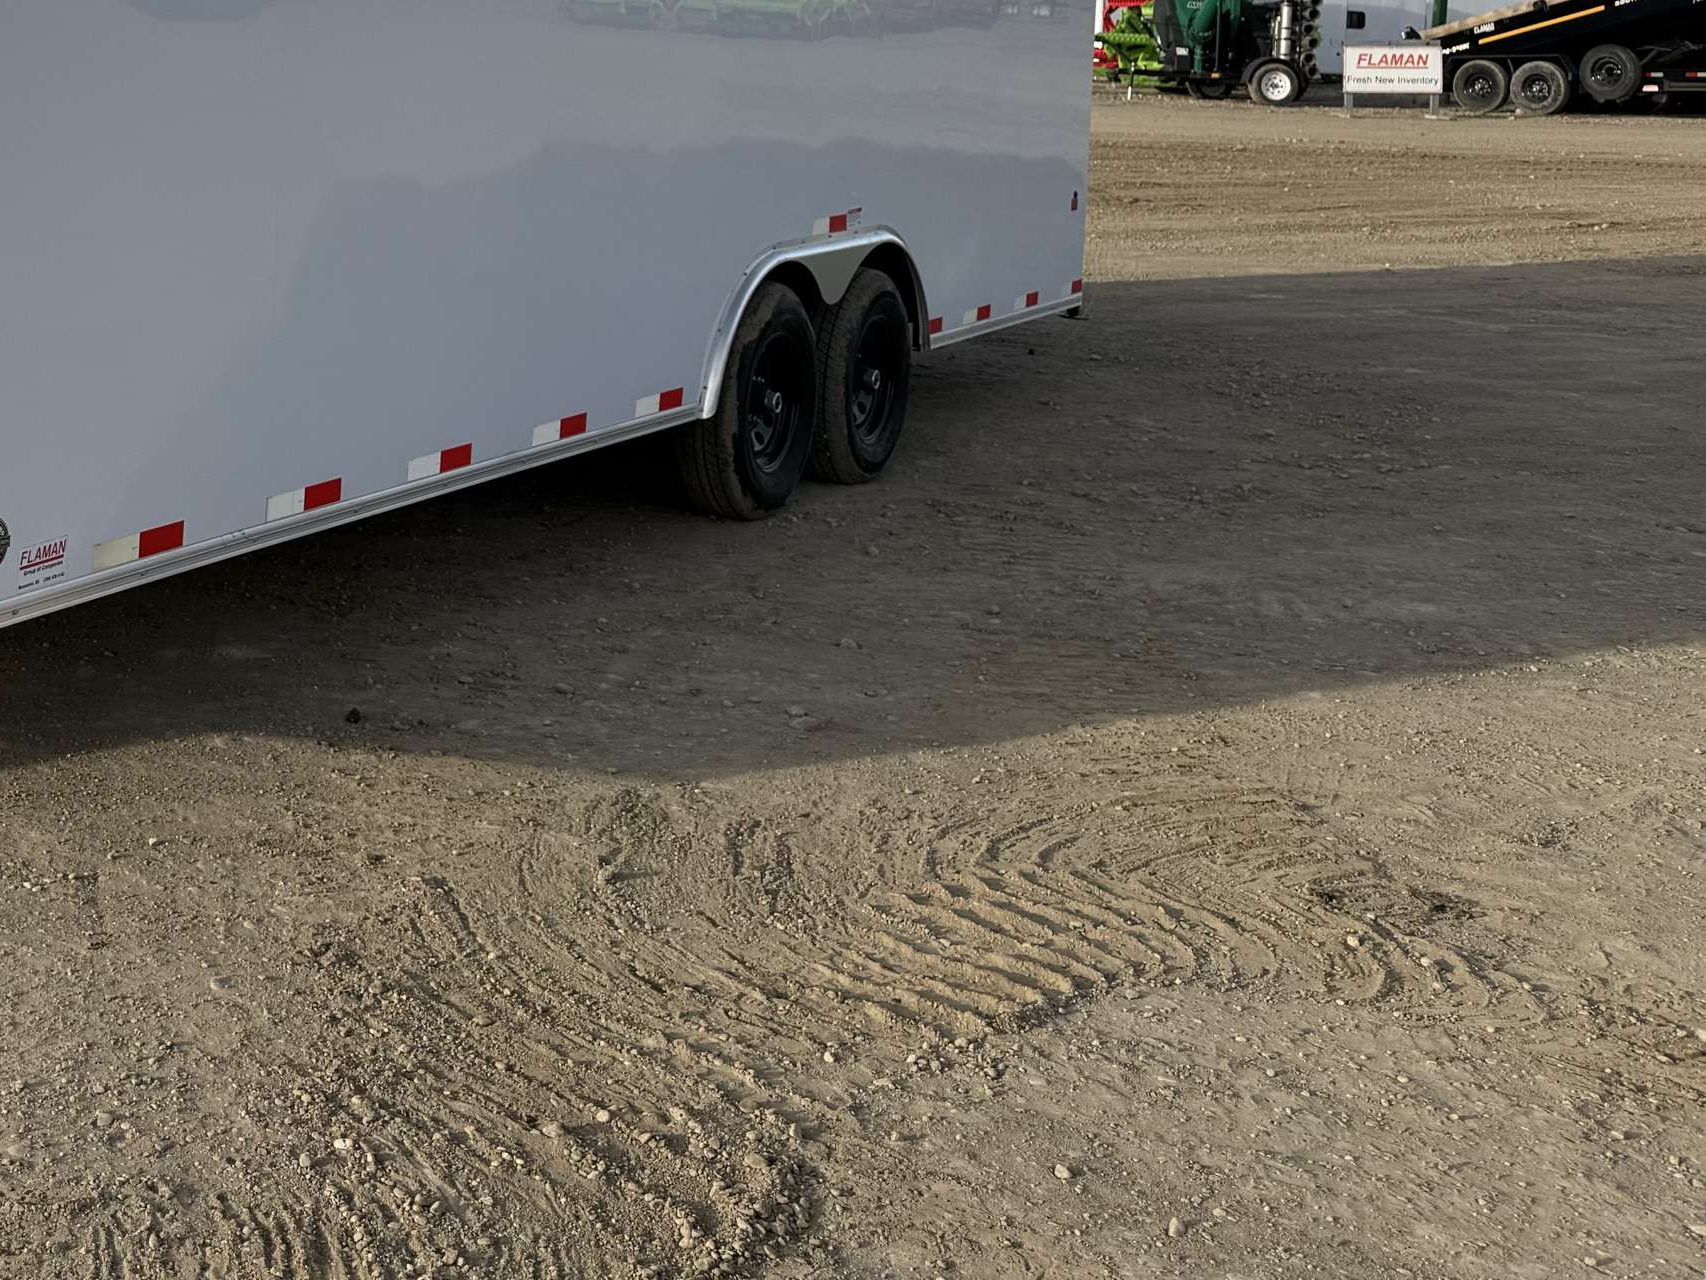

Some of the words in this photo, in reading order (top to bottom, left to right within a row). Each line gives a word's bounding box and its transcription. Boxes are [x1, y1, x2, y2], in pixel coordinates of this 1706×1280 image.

[1356, 53, 1430, 67] FLAMAN
[1347, 75, 1372, 84] Fresh
[1375, 75, 1395, 84] New
[1397, 75, 1439, 87] Inventory
[20, 538, 67, 566] FLAMAN
